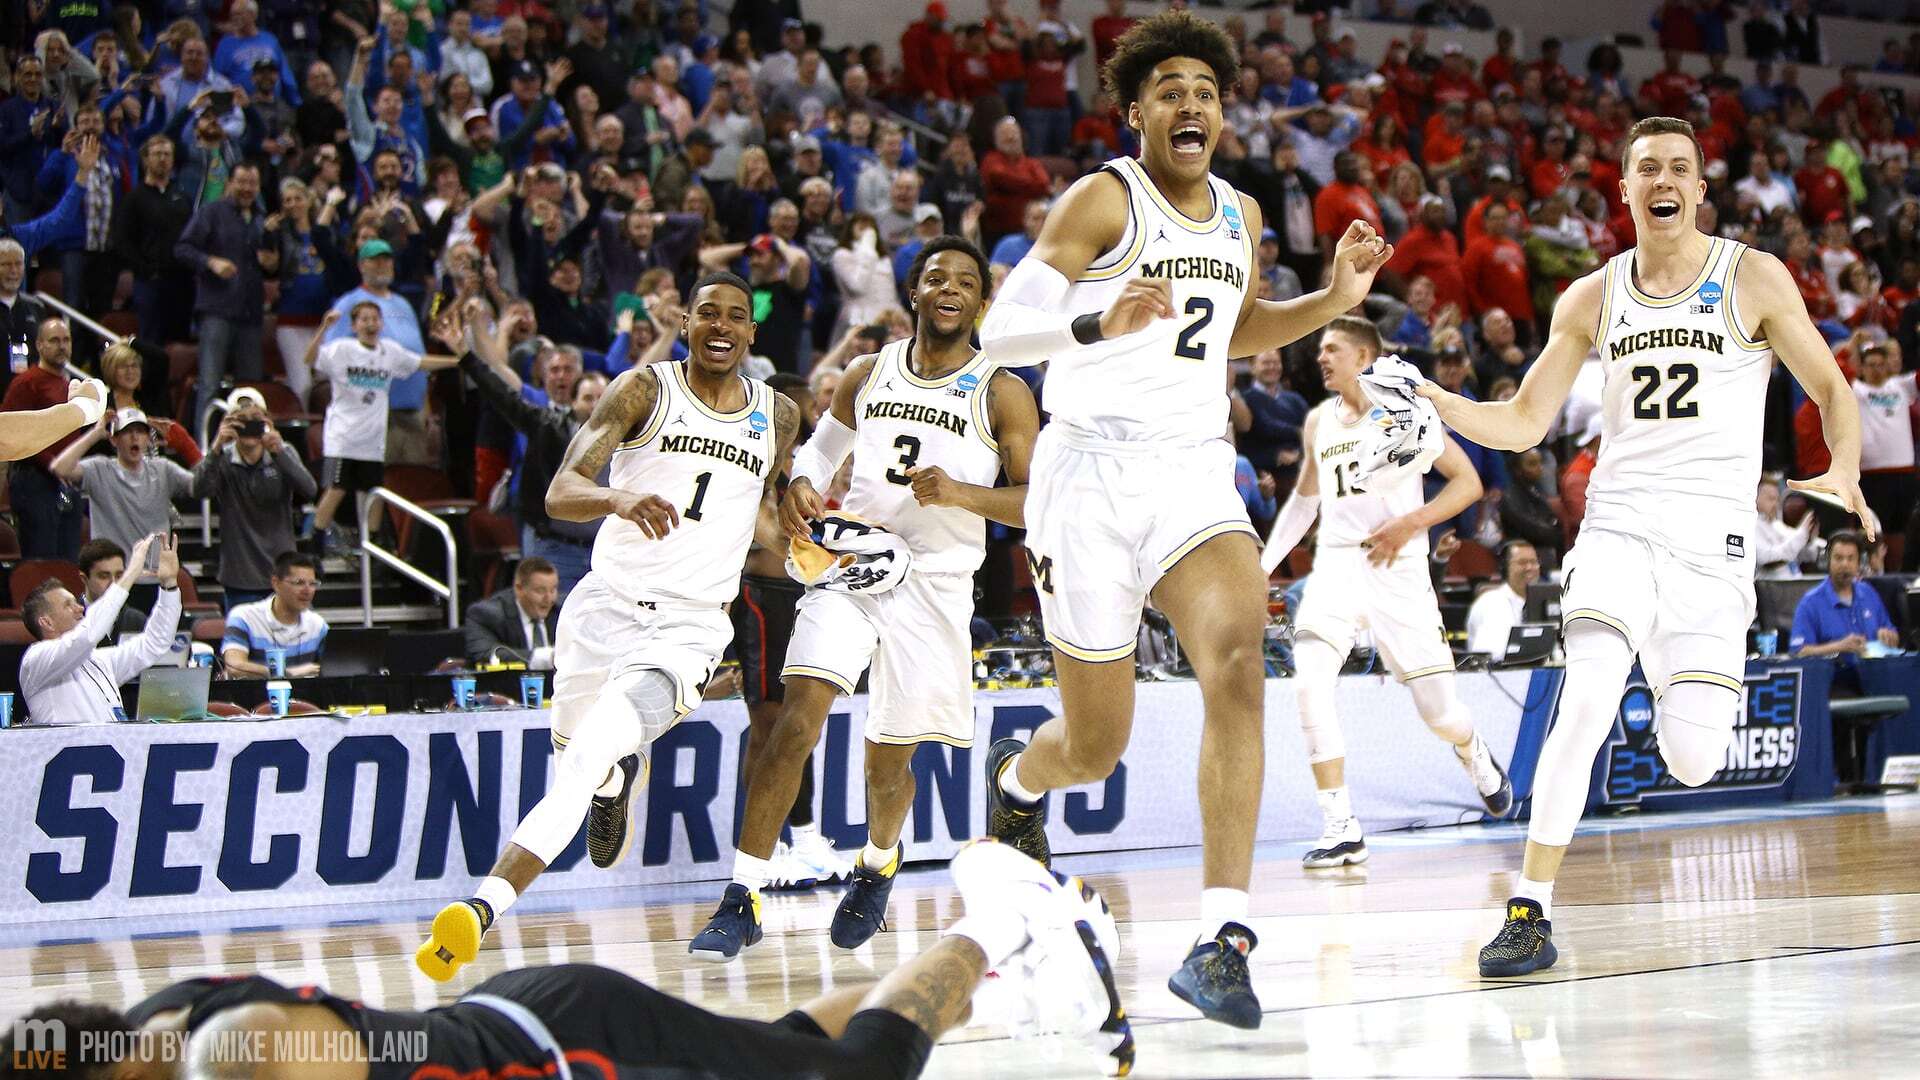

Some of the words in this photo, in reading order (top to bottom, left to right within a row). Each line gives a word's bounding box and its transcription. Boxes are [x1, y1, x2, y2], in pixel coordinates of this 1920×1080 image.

[59, 2, 98, 17] adidas
[1142, 257, 1244, 292] MICHIGAN
[1174, 296, 1214, 360] 2
[1609, 328, 1724, 361] MICHIGAN
[1632, 363, 1698, 419] 22
[864, 401, 968, 437] MICHIGAN
[660, 435, 764, 477] MICHIGAN
[886, 434, 921, 486] 3
[684, 471, 712, 522] 1
[1718, 726, 1796, 771] NESS
[1510, 905, 1530, 921] M
